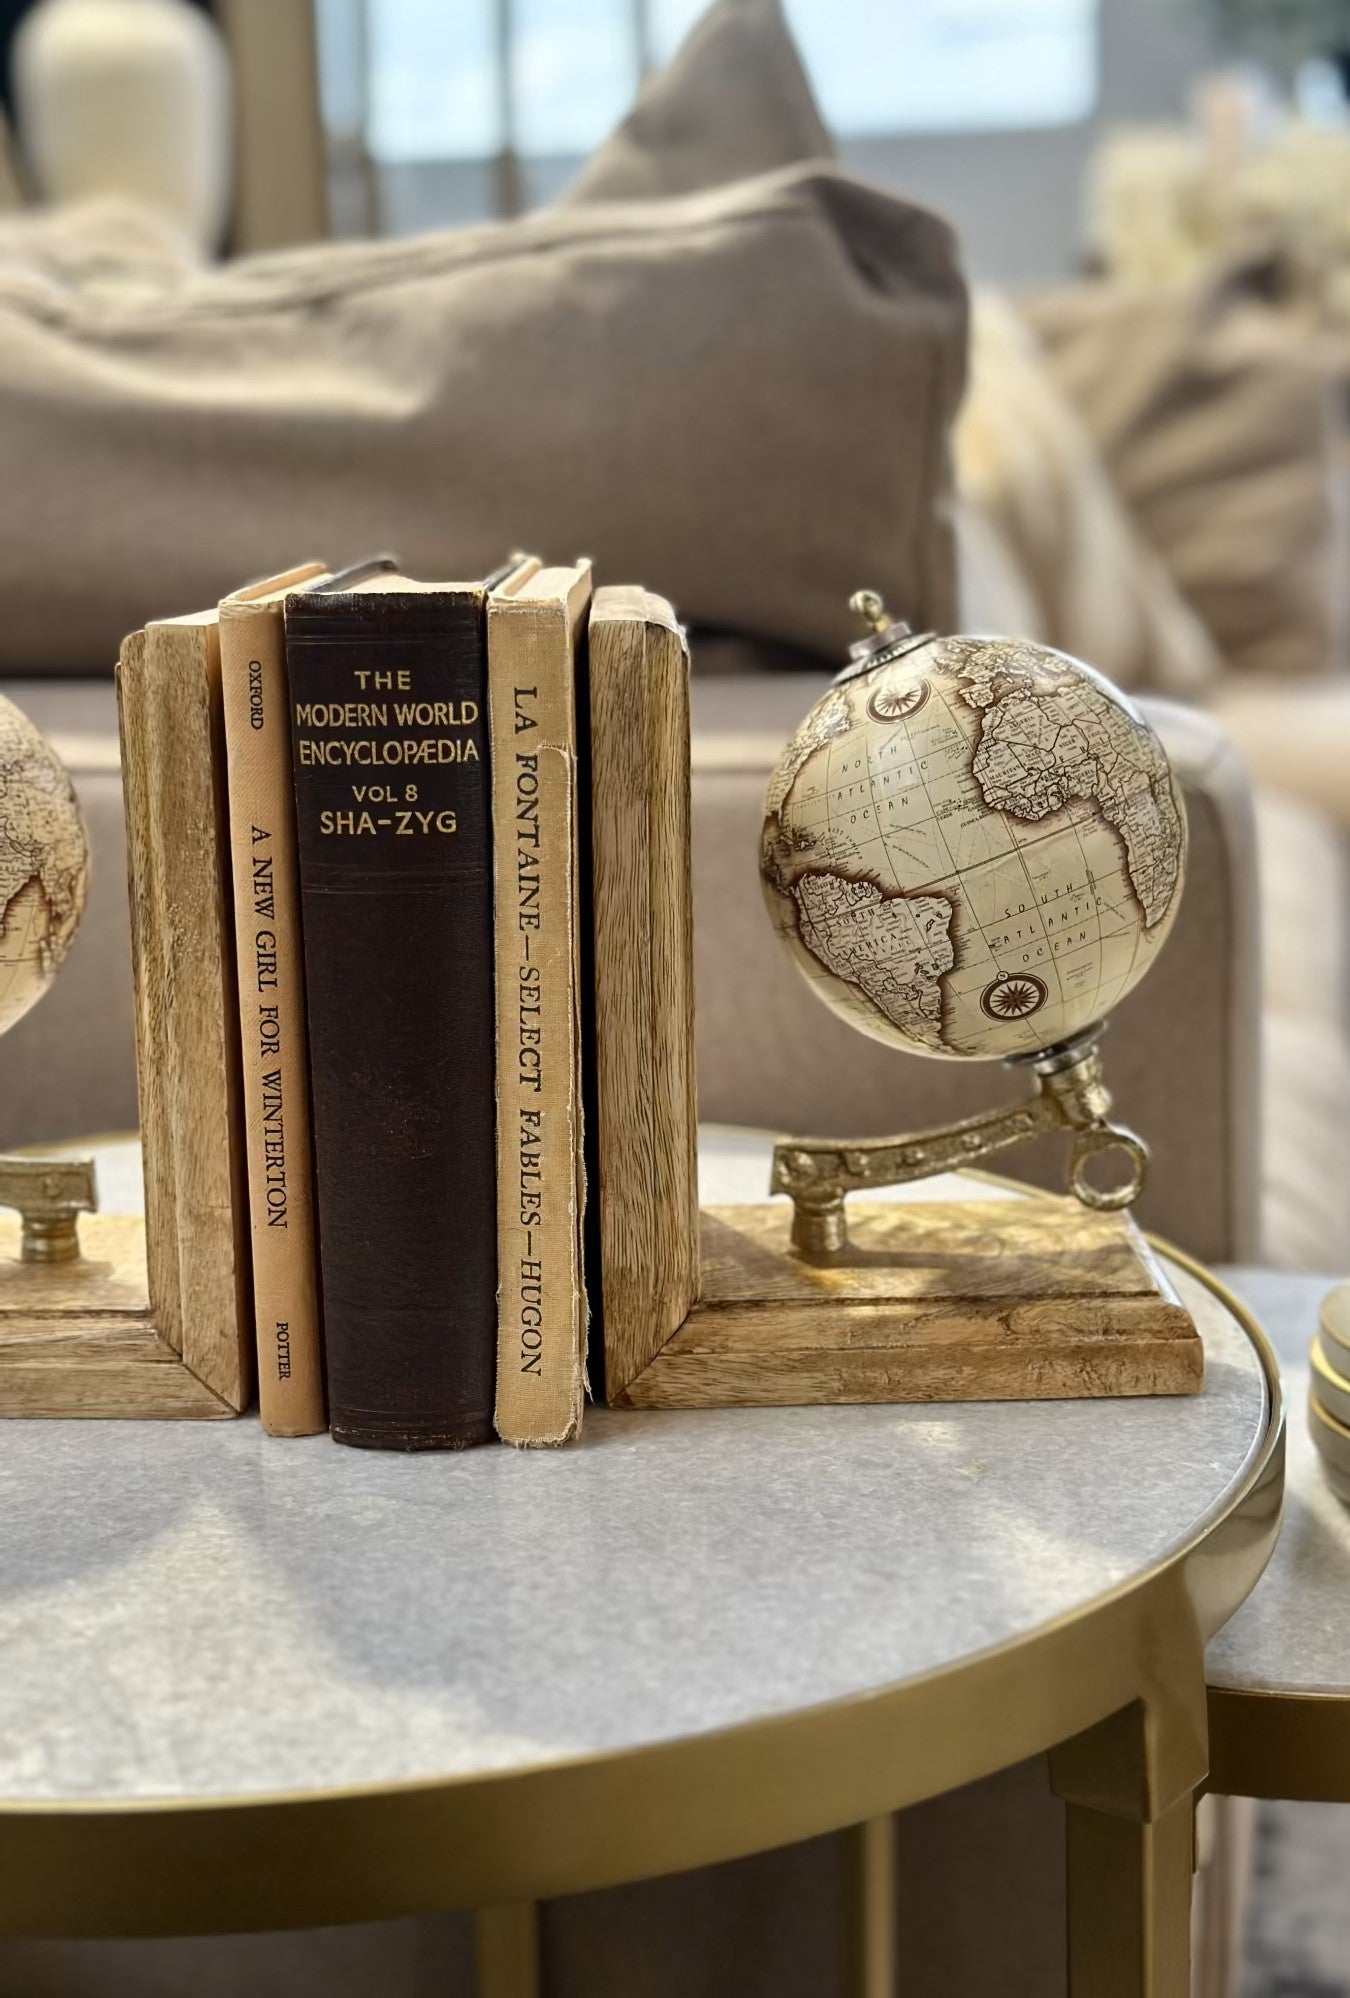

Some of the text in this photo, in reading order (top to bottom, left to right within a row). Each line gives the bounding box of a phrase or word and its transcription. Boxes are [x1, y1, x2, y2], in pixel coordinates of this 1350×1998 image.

[248, 660, 264, 731] OXFORD
[354, 670, 411, 690] THE
[296, 701, 479, 727] MODERN WORLD
[513, 686, 538, 735] LA
[299, 738, 479, 765] ENCYCLOPÆDIA
[841, 745, 898, 774] NORTH
[351, 784, 419, 803] VOL 8
[837, 760, 929, 801] ATLANTIC
[320, 810, 457, 835] SHA-ZYG
[849, 796, 909, 825] OCEAN
[1004, 882, 1074, 919] SOUTH
[1003, 896, 1102, 945] ATLANTIC
[842, 932, 898, 958] AMERICA
[1022, 930, 1087, 964] OCEAN
[251, 825, 288, 1229] A NEW GIRL FOR WINTERTON
[276, 1322, 292, 1381] POTTER
